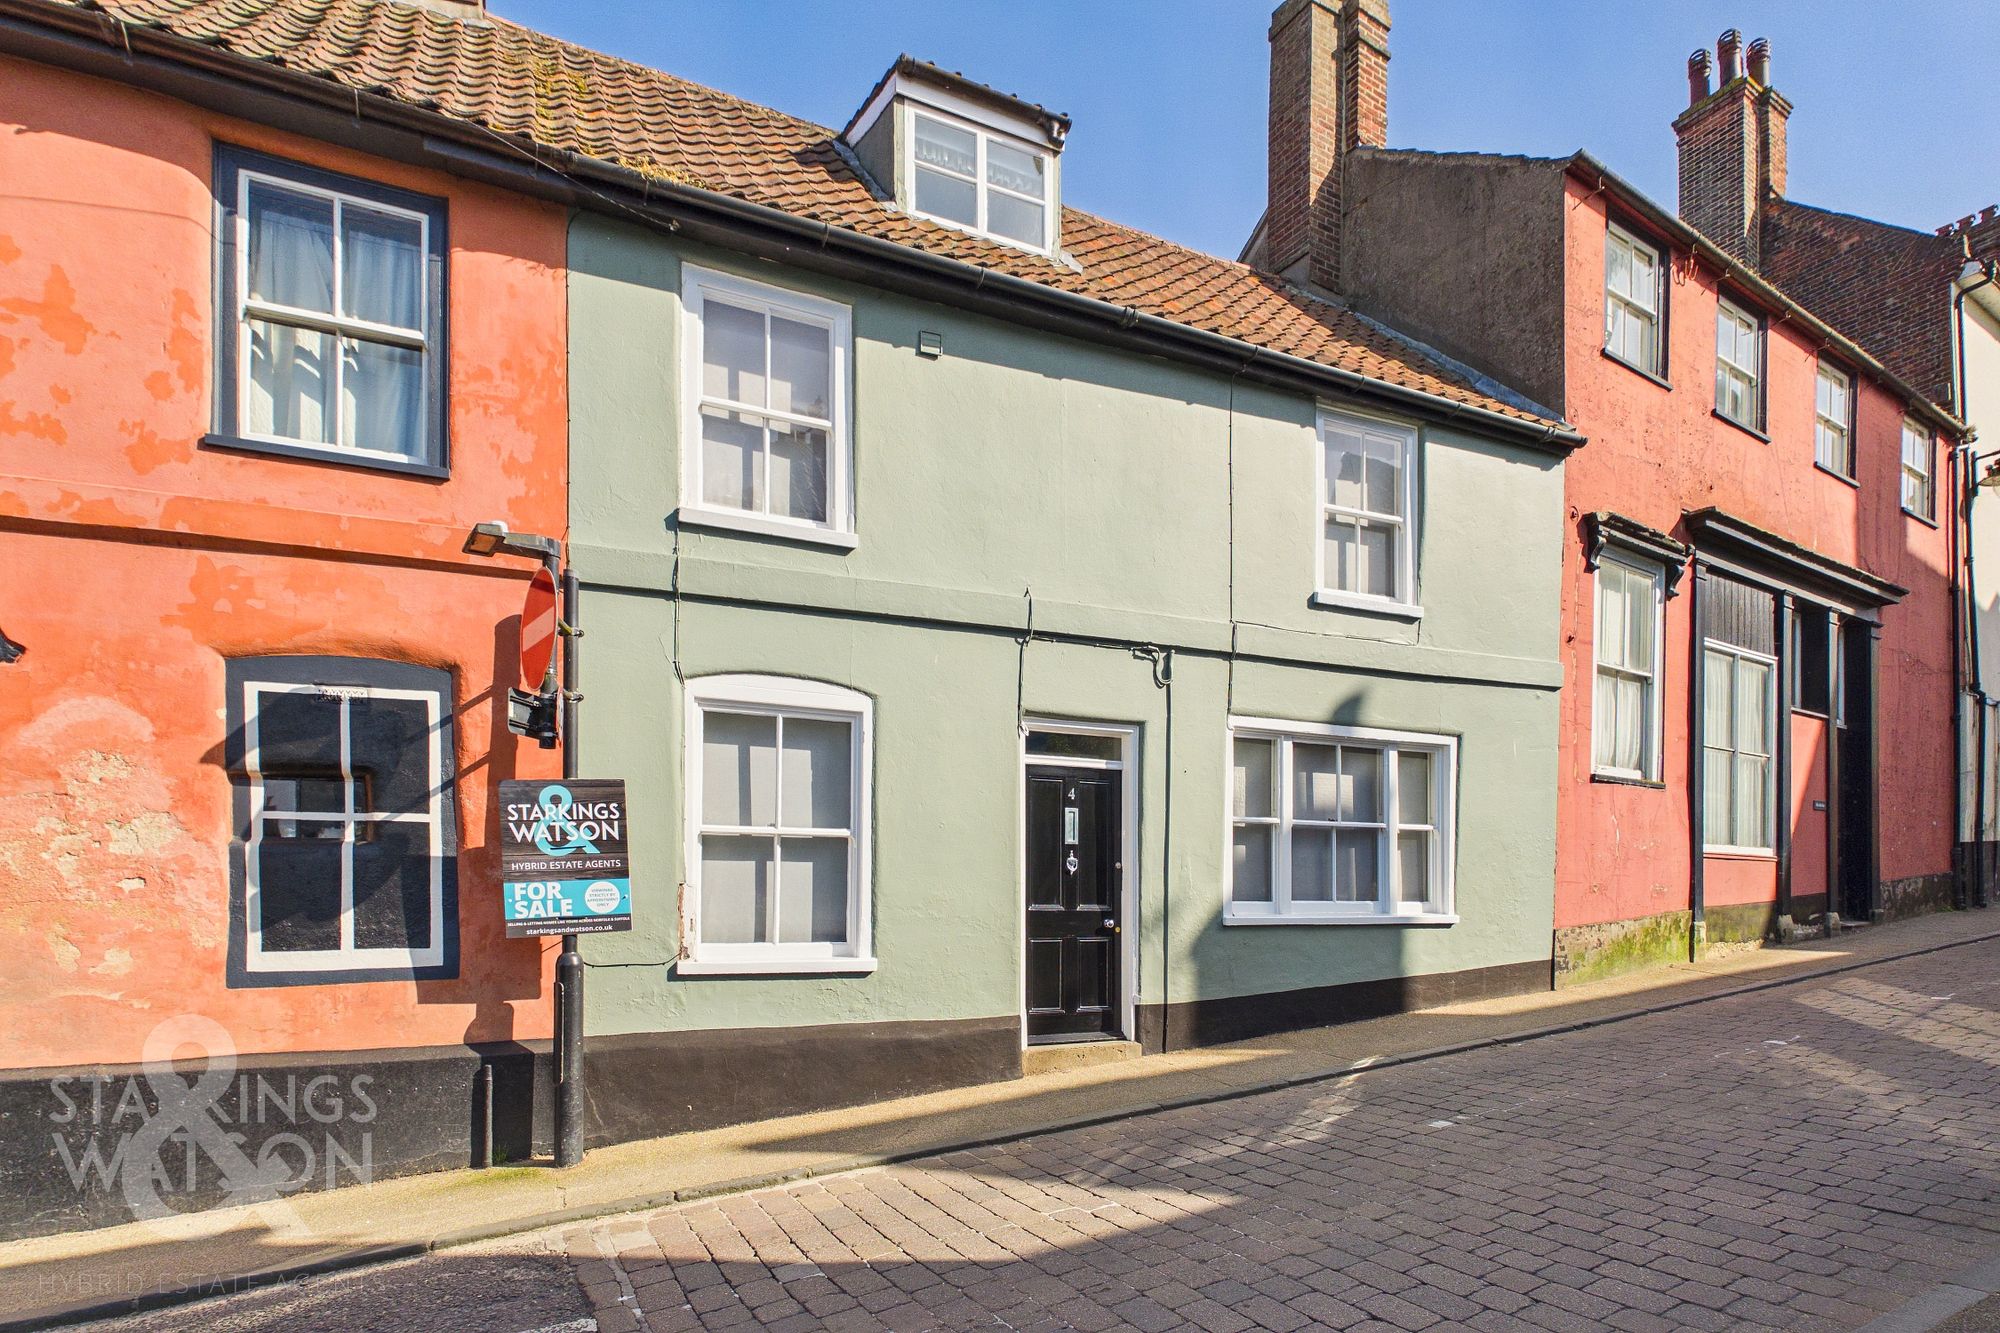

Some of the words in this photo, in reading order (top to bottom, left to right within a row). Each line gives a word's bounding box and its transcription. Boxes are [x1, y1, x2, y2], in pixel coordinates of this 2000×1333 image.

[1067, 787, 1076, 800] 4
[507, 803, 620, 821] STARKINGS
[508, 820, 620, 843] WATSON
[511, 862, 547, 871] HYBRID
[549, 860, 583, 870] ESTATE
[584, 859, 621, 869] AGENTS
[514, 882, 563, 901] FOR
[514, 899, 574, 919] SALE
[526, 924, 613, 936] starkingsandwatson.co.uk
